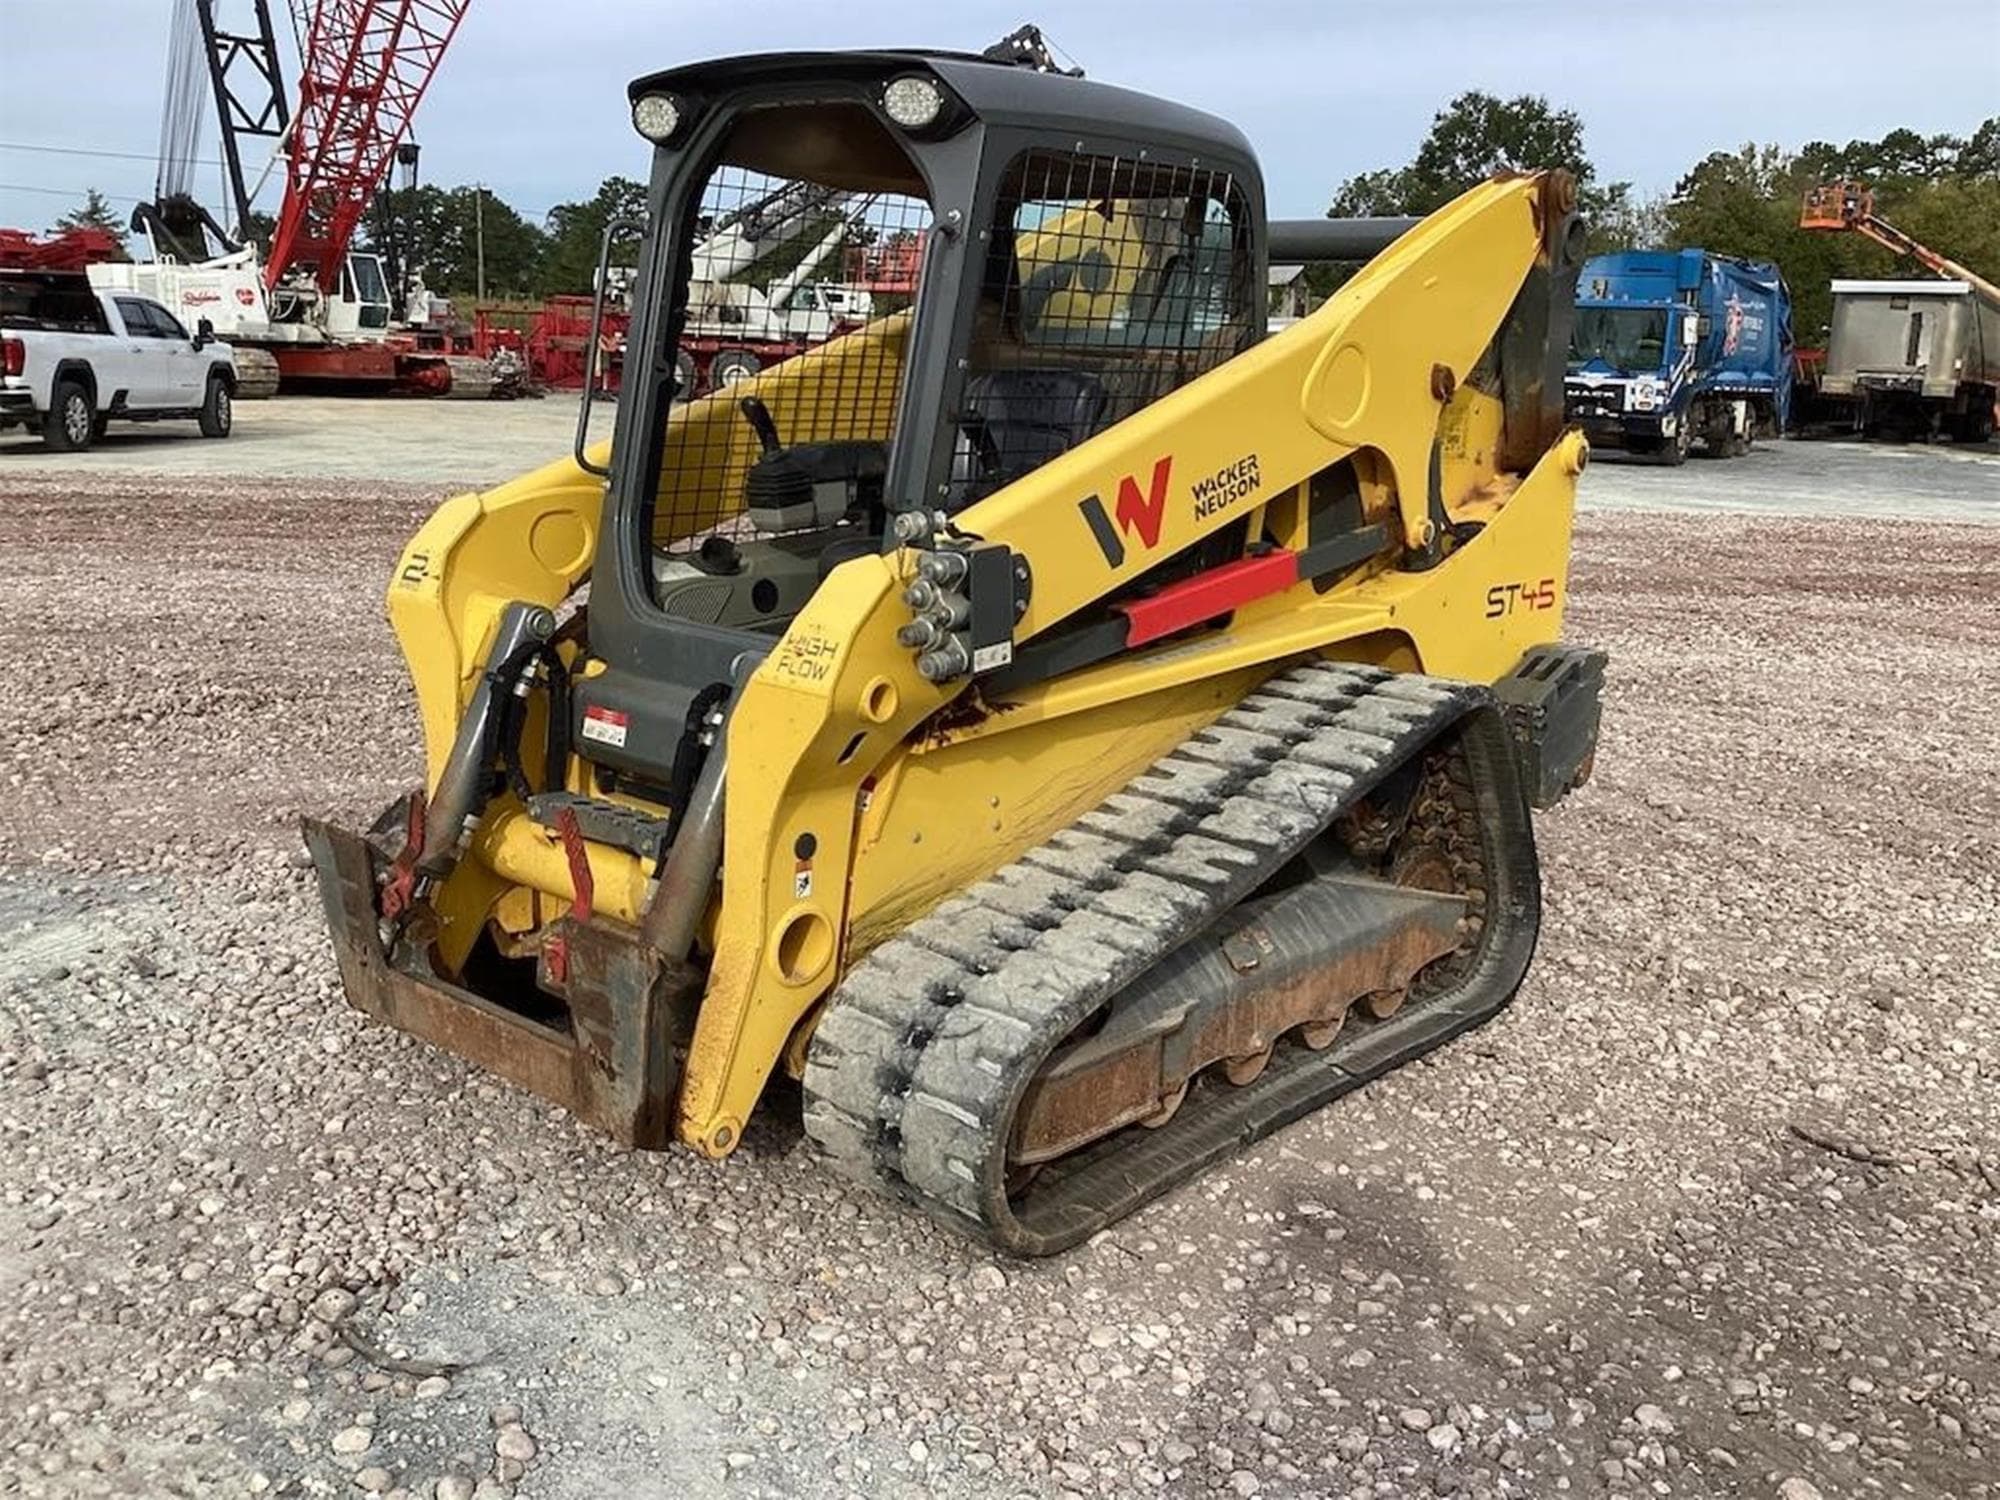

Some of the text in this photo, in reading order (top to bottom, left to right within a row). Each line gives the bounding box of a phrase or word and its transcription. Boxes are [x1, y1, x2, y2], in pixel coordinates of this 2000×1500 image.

[1566, 389, 1616, 399] MACK
[1191, 454, 1259, 501] WACKER
[1194, 472, 1261, 522] NEUSON
[1485, 578, 1555, 618] ST45
[776, 655, 830, 680] FLOW
